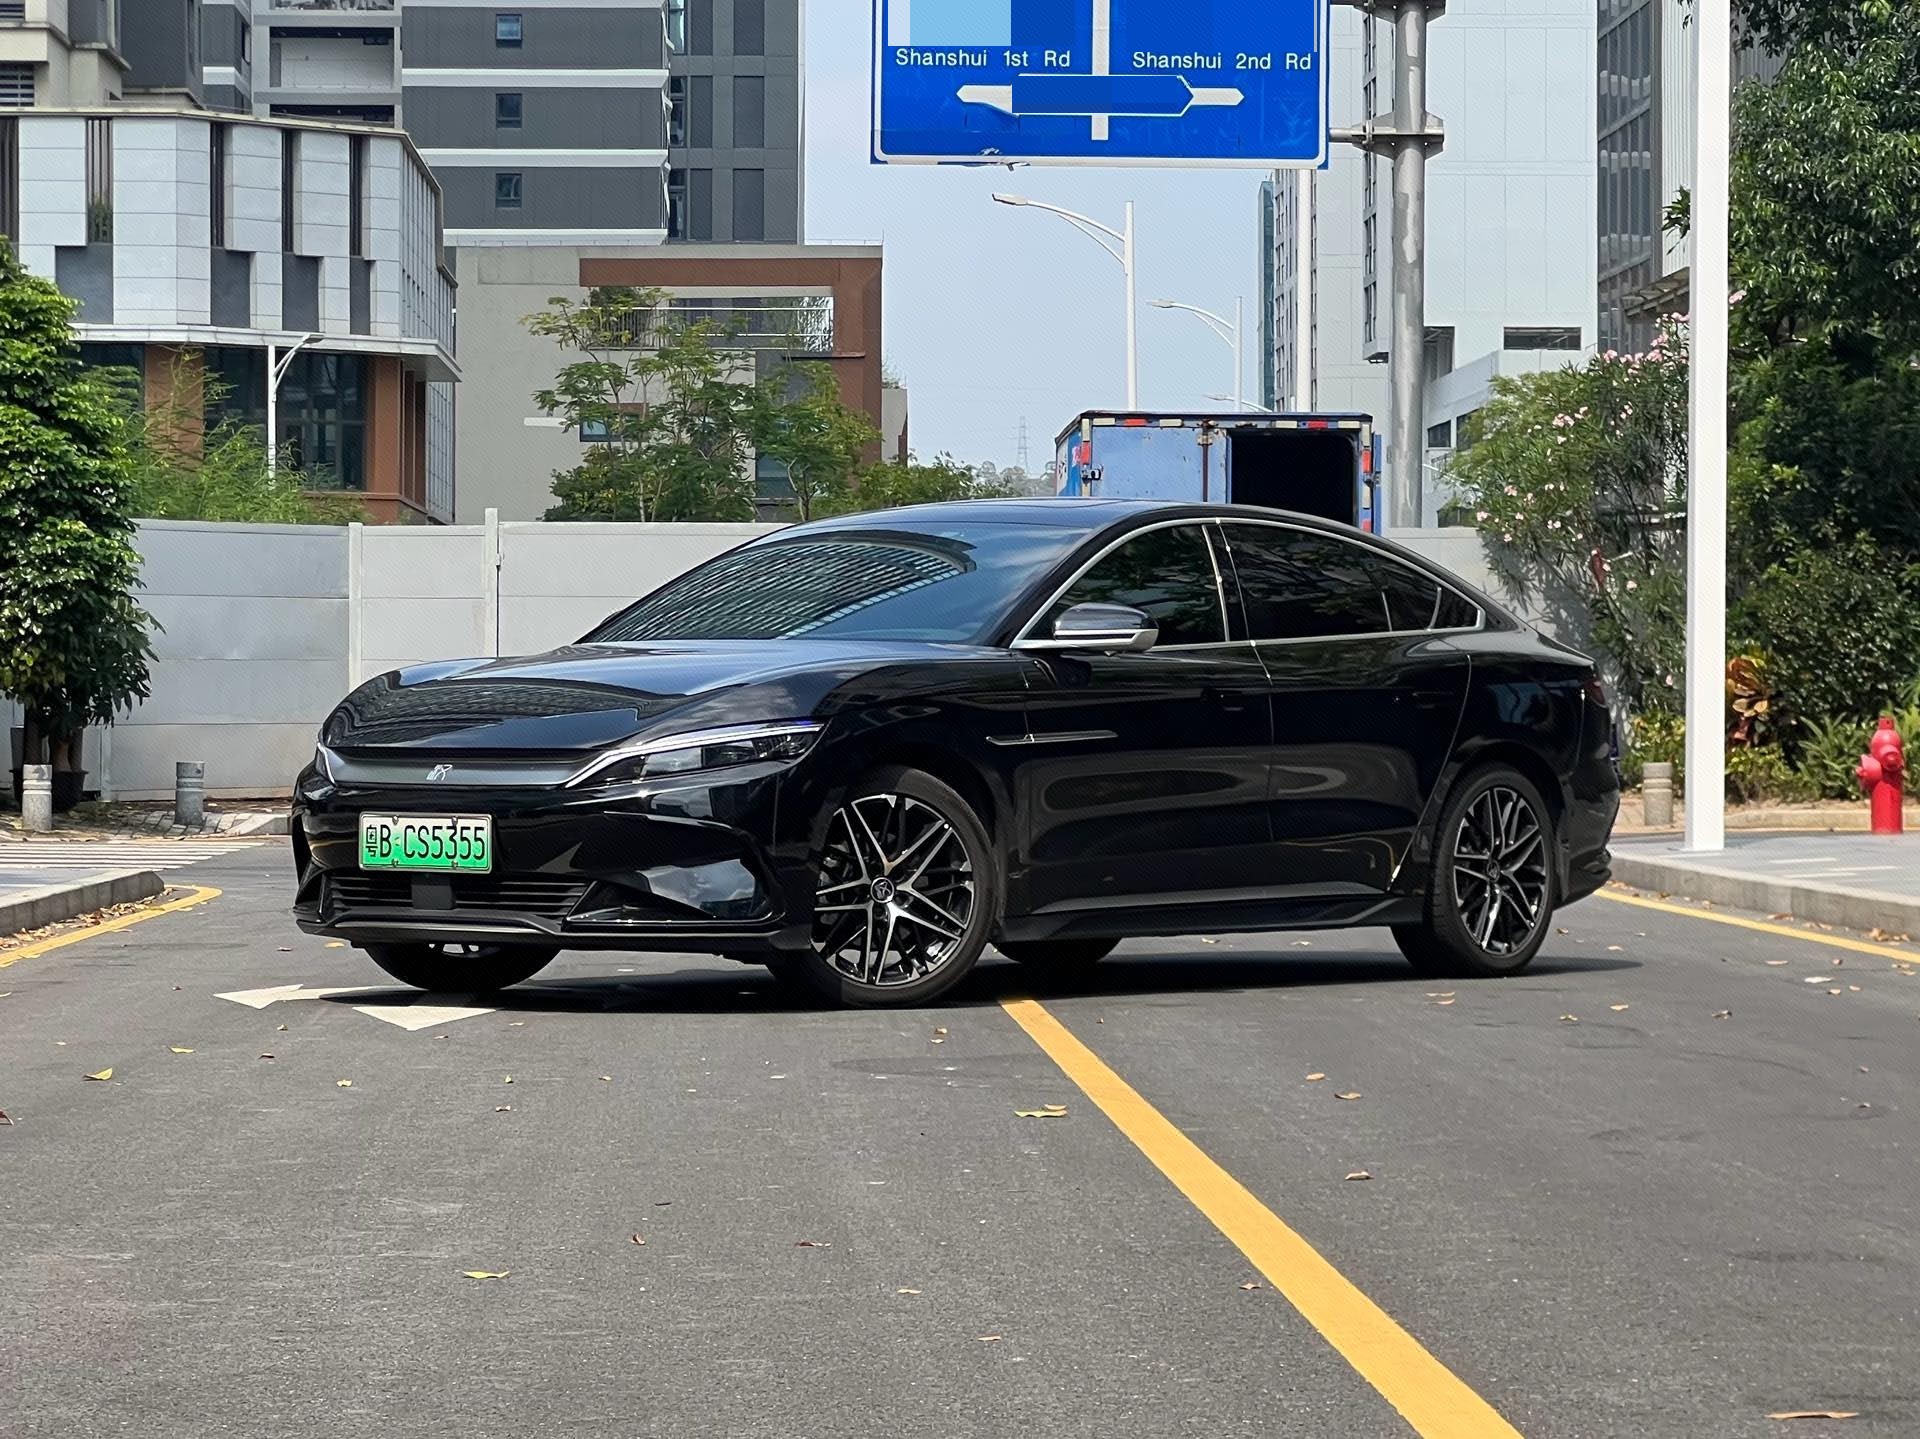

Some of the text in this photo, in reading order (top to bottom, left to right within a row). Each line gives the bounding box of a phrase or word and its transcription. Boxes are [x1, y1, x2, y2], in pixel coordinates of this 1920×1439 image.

[896, 48, 1071, 67] Shanshui 1st Rd
[1132, 51, 1312, 70] Shanshui 2nd Rd
